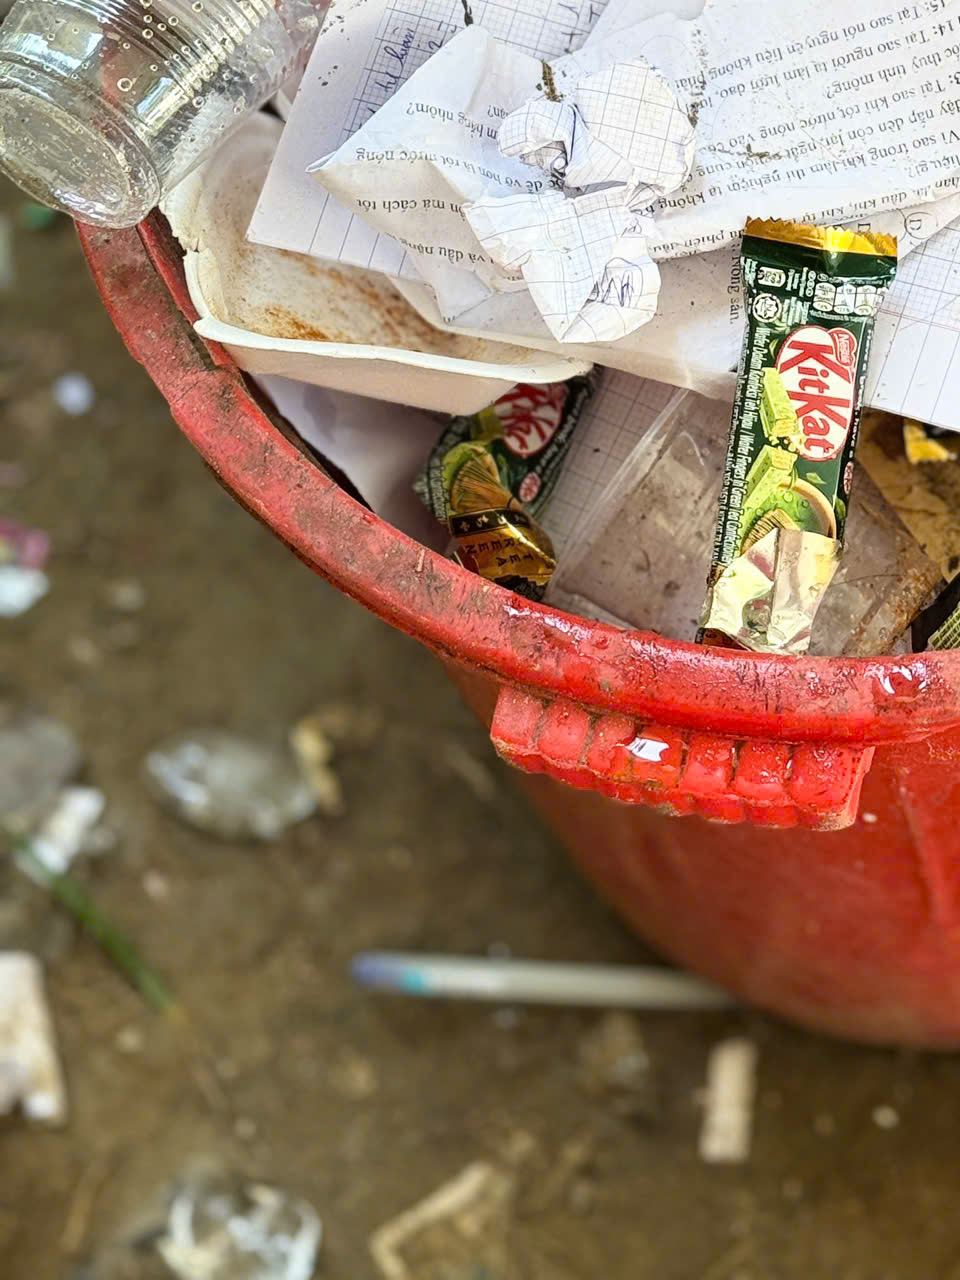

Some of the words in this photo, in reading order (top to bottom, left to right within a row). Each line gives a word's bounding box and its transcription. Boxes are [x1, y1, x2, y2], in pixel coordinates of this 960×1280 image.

[870, 15, 893, 28] sao
[897, 6, 922, 24] Tại
[842, 23, 865, 41] nói
[933, 21, 953, 36] 14:
[787, 31, 839, 55] nguyên
[878, 40, 900, 52] sao
[905, 30, 930, 48] Tại
[755, 48, 783, 63] liệu
[832, 47, 873, 71] người
[707, 56, 751, 83] không
[783, 67, 810, 80] làm
[812, 62, 827, 72] ta
[716, 84, 745, 98] dao,
[892, 88, 915, 102] sao
[920, 80, 945, 97] Tại
[406, 103, 453, 122] nhôm?
[839, 105, 860, 119] rót
[865, 97, 888, 114] khi
[800, 112, 835, 129] nước
[760, 122, 795, 138] nóng
[821, 131, 844, 150] lại,
[356, 148, 394, 164] nóng
[787, 139, 817, 162] ngắt
[868, 143, 909, 160] trong
[440, 156, 459, 168] rót
[478, 167, 501, 184] hơn
[505, 177, 521, 188] vỡ
[727, 169, 781, 191] nghiệm
[526, 181, 542, 194] dễ
[383, 200, 417, 213] cách
[658, 189, 705, 209] không
[439, 247, 463, 264] dầu
[837, 333, 850, 366] Nestlé
[779, 340, 851, 455] KitKat
